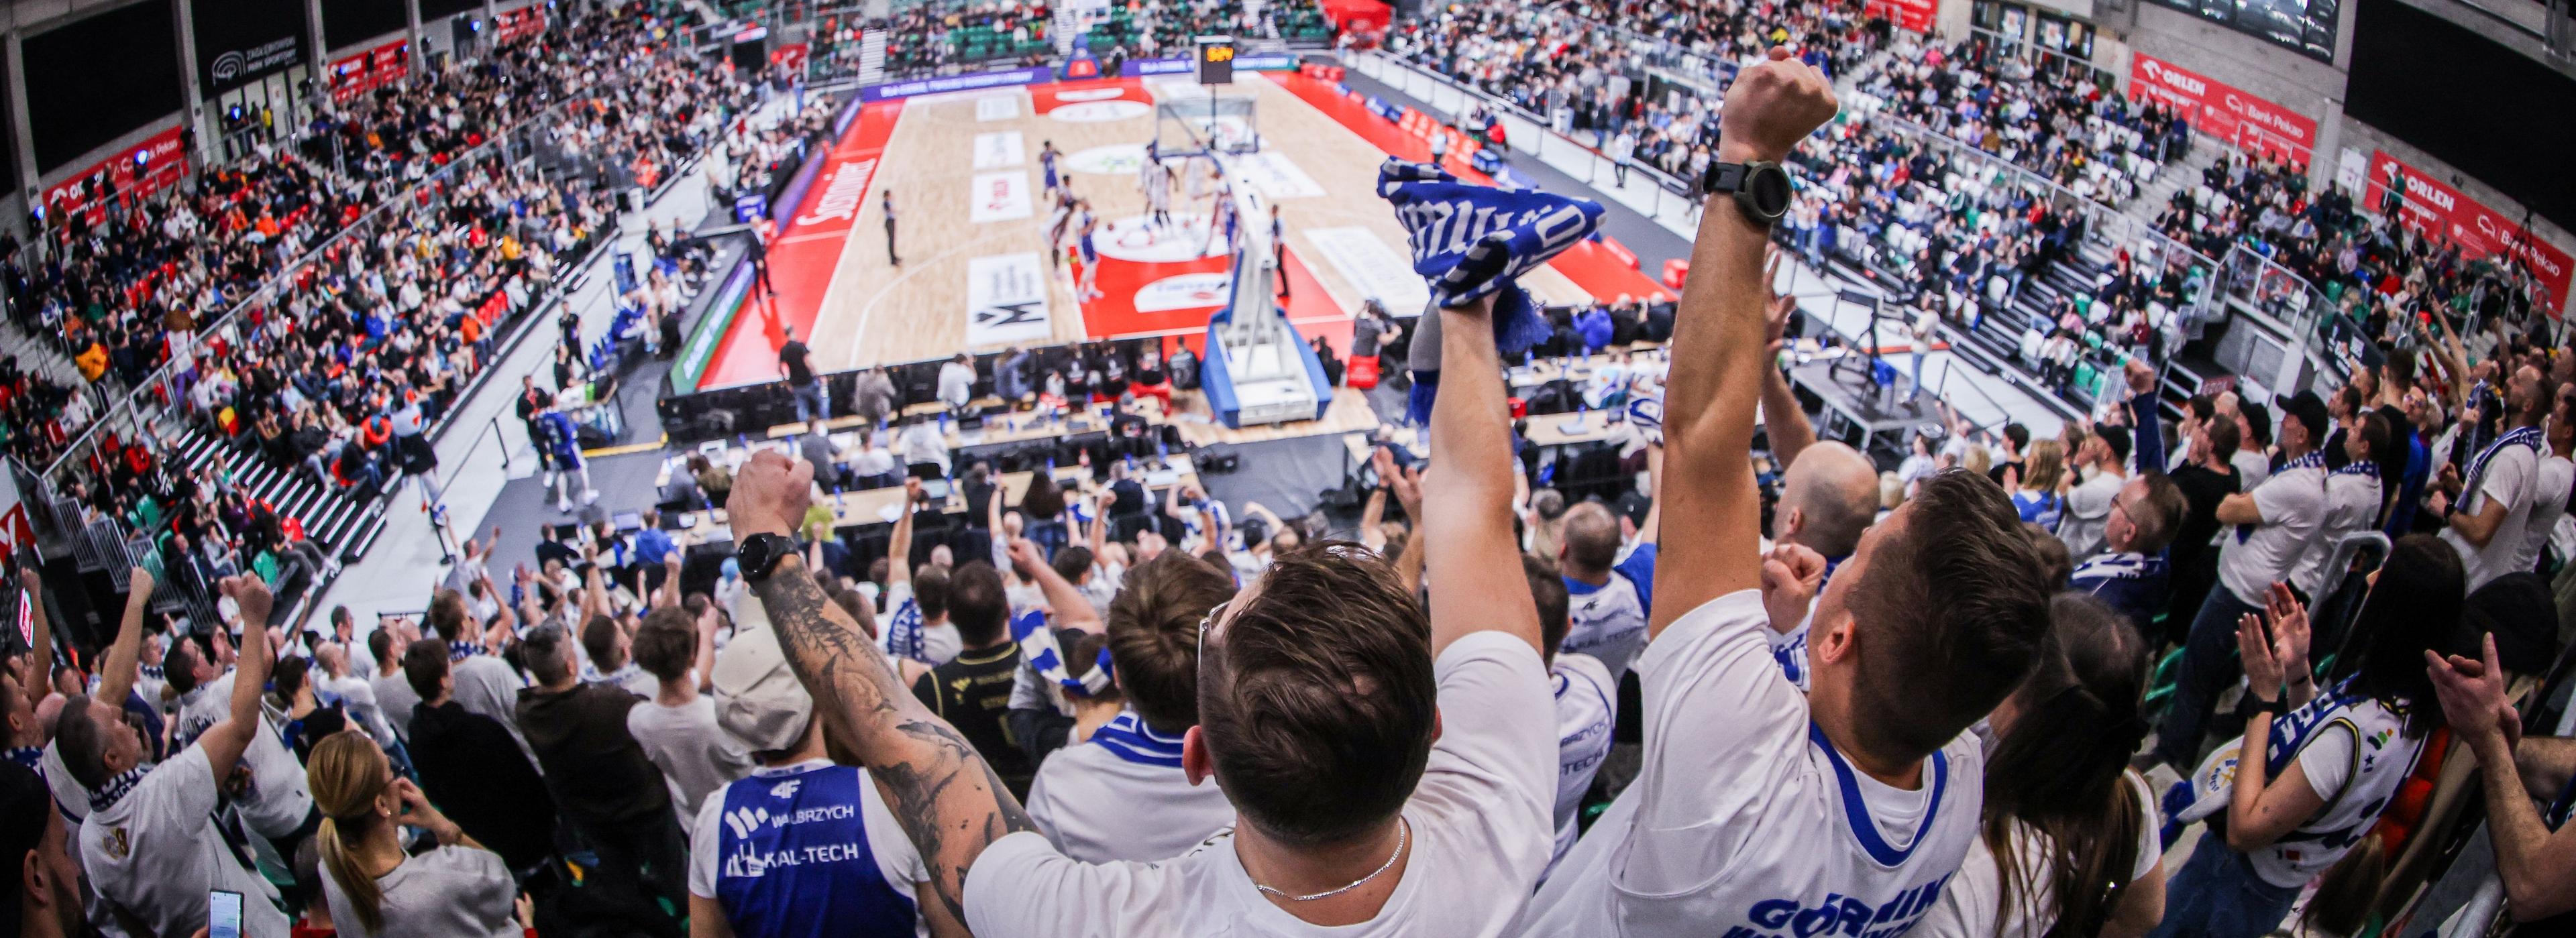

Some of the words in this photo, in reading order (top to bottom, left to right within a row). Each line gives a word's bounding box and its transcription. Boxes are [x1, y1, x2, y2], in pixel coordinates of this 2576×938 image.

[2161, 72, 2206, 97] ORLEN
[2249, 104, 2273, 125] Bank
[2406, 176, 2456, 212] ORLEN
[770, 779, 801, 799] 4F
[764, 842, 859, 868] KAL-TECH
[1748, 870, 1953, 938] GÓRNIK
